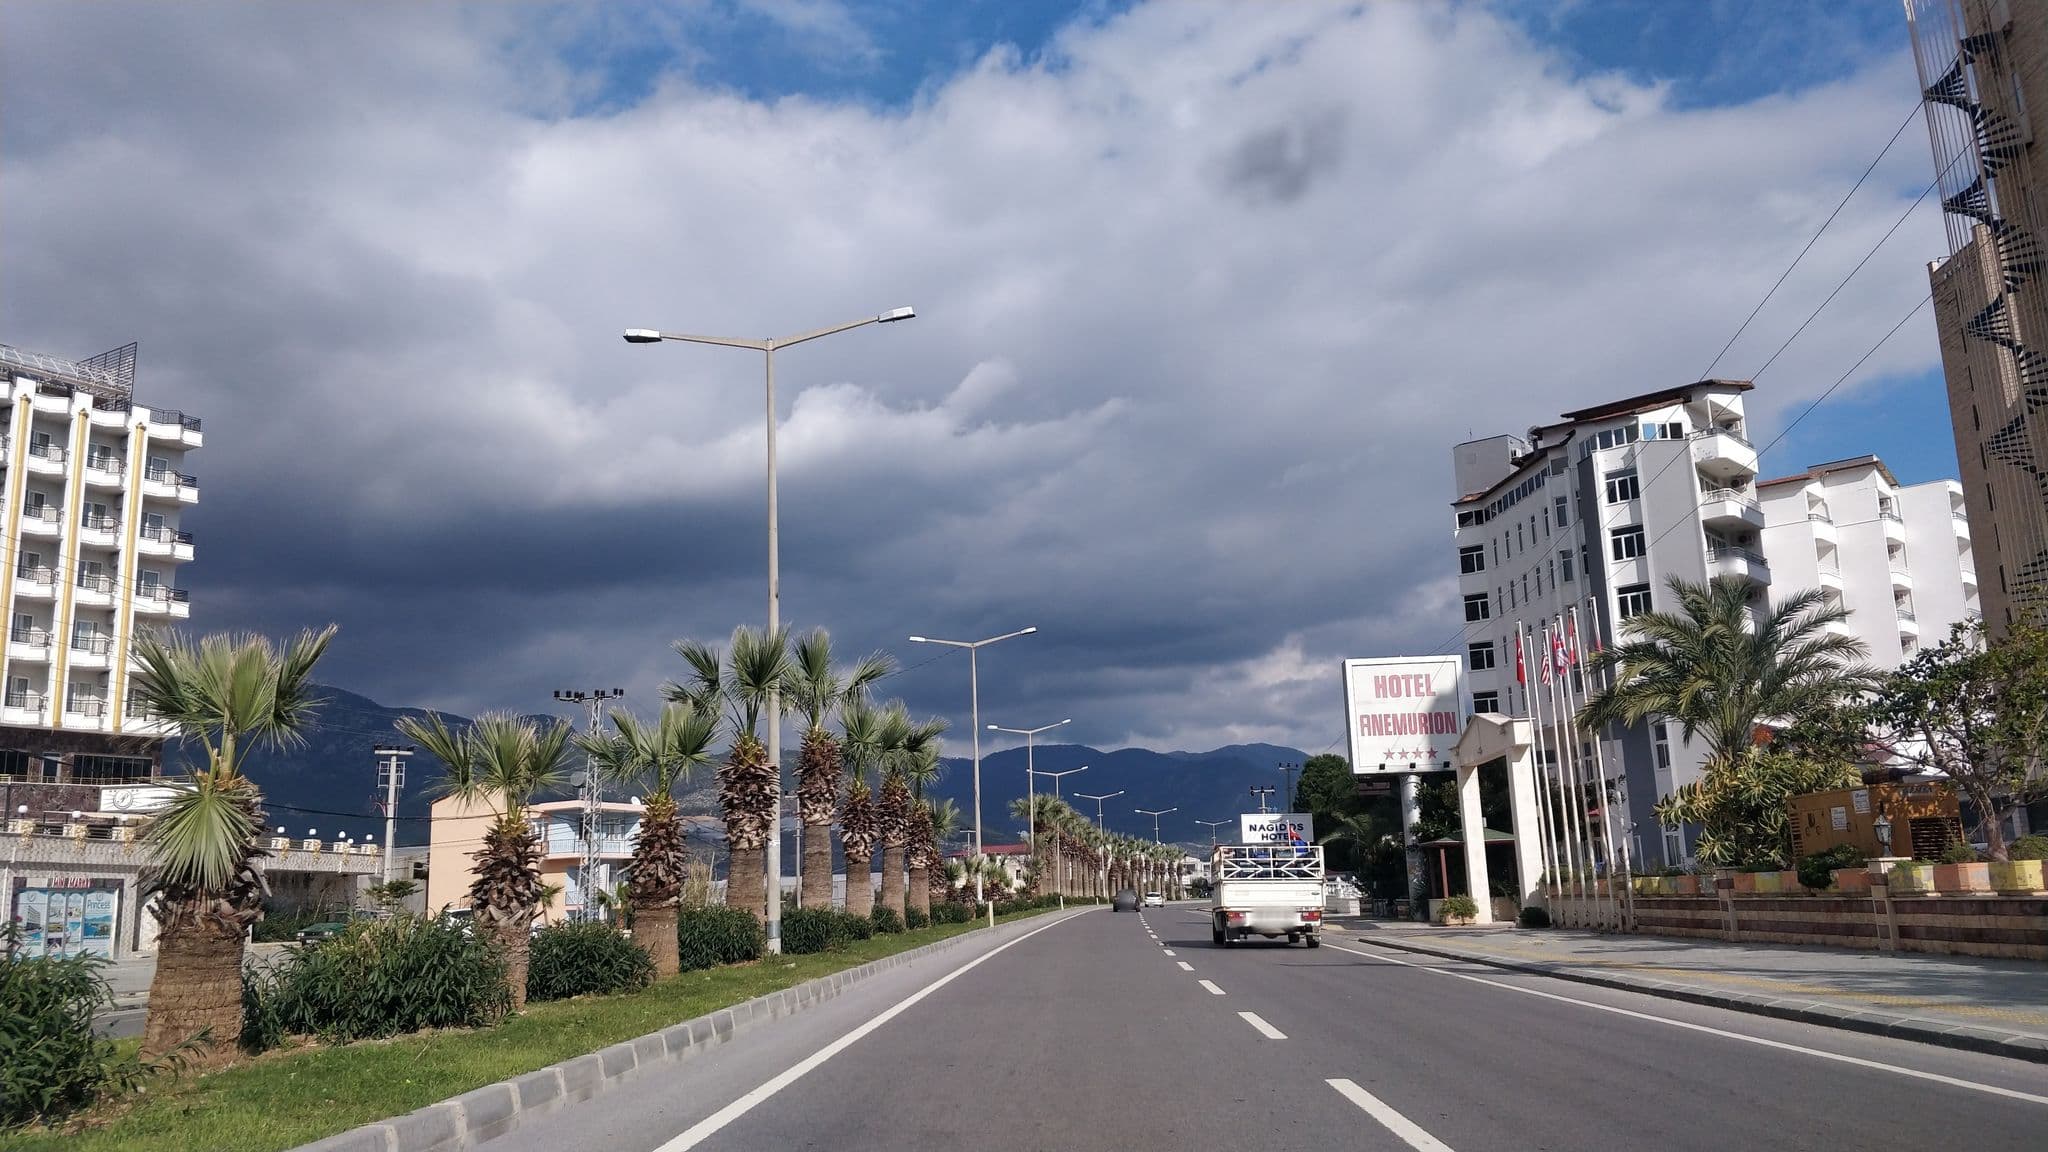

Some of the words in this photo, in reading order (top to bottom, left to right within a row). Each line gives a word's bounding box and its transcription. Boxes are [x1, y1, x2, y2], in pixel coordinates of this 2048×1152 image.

[1374, 673, 1436, 698] HOTEL
[1359, 711, 1457, 736] ANEMURION
[1248, 823, 1304, 832] NAGIDOS
[1261, 832, 1290, 841] HOTE
[87, 899, 111, 910] Princess
